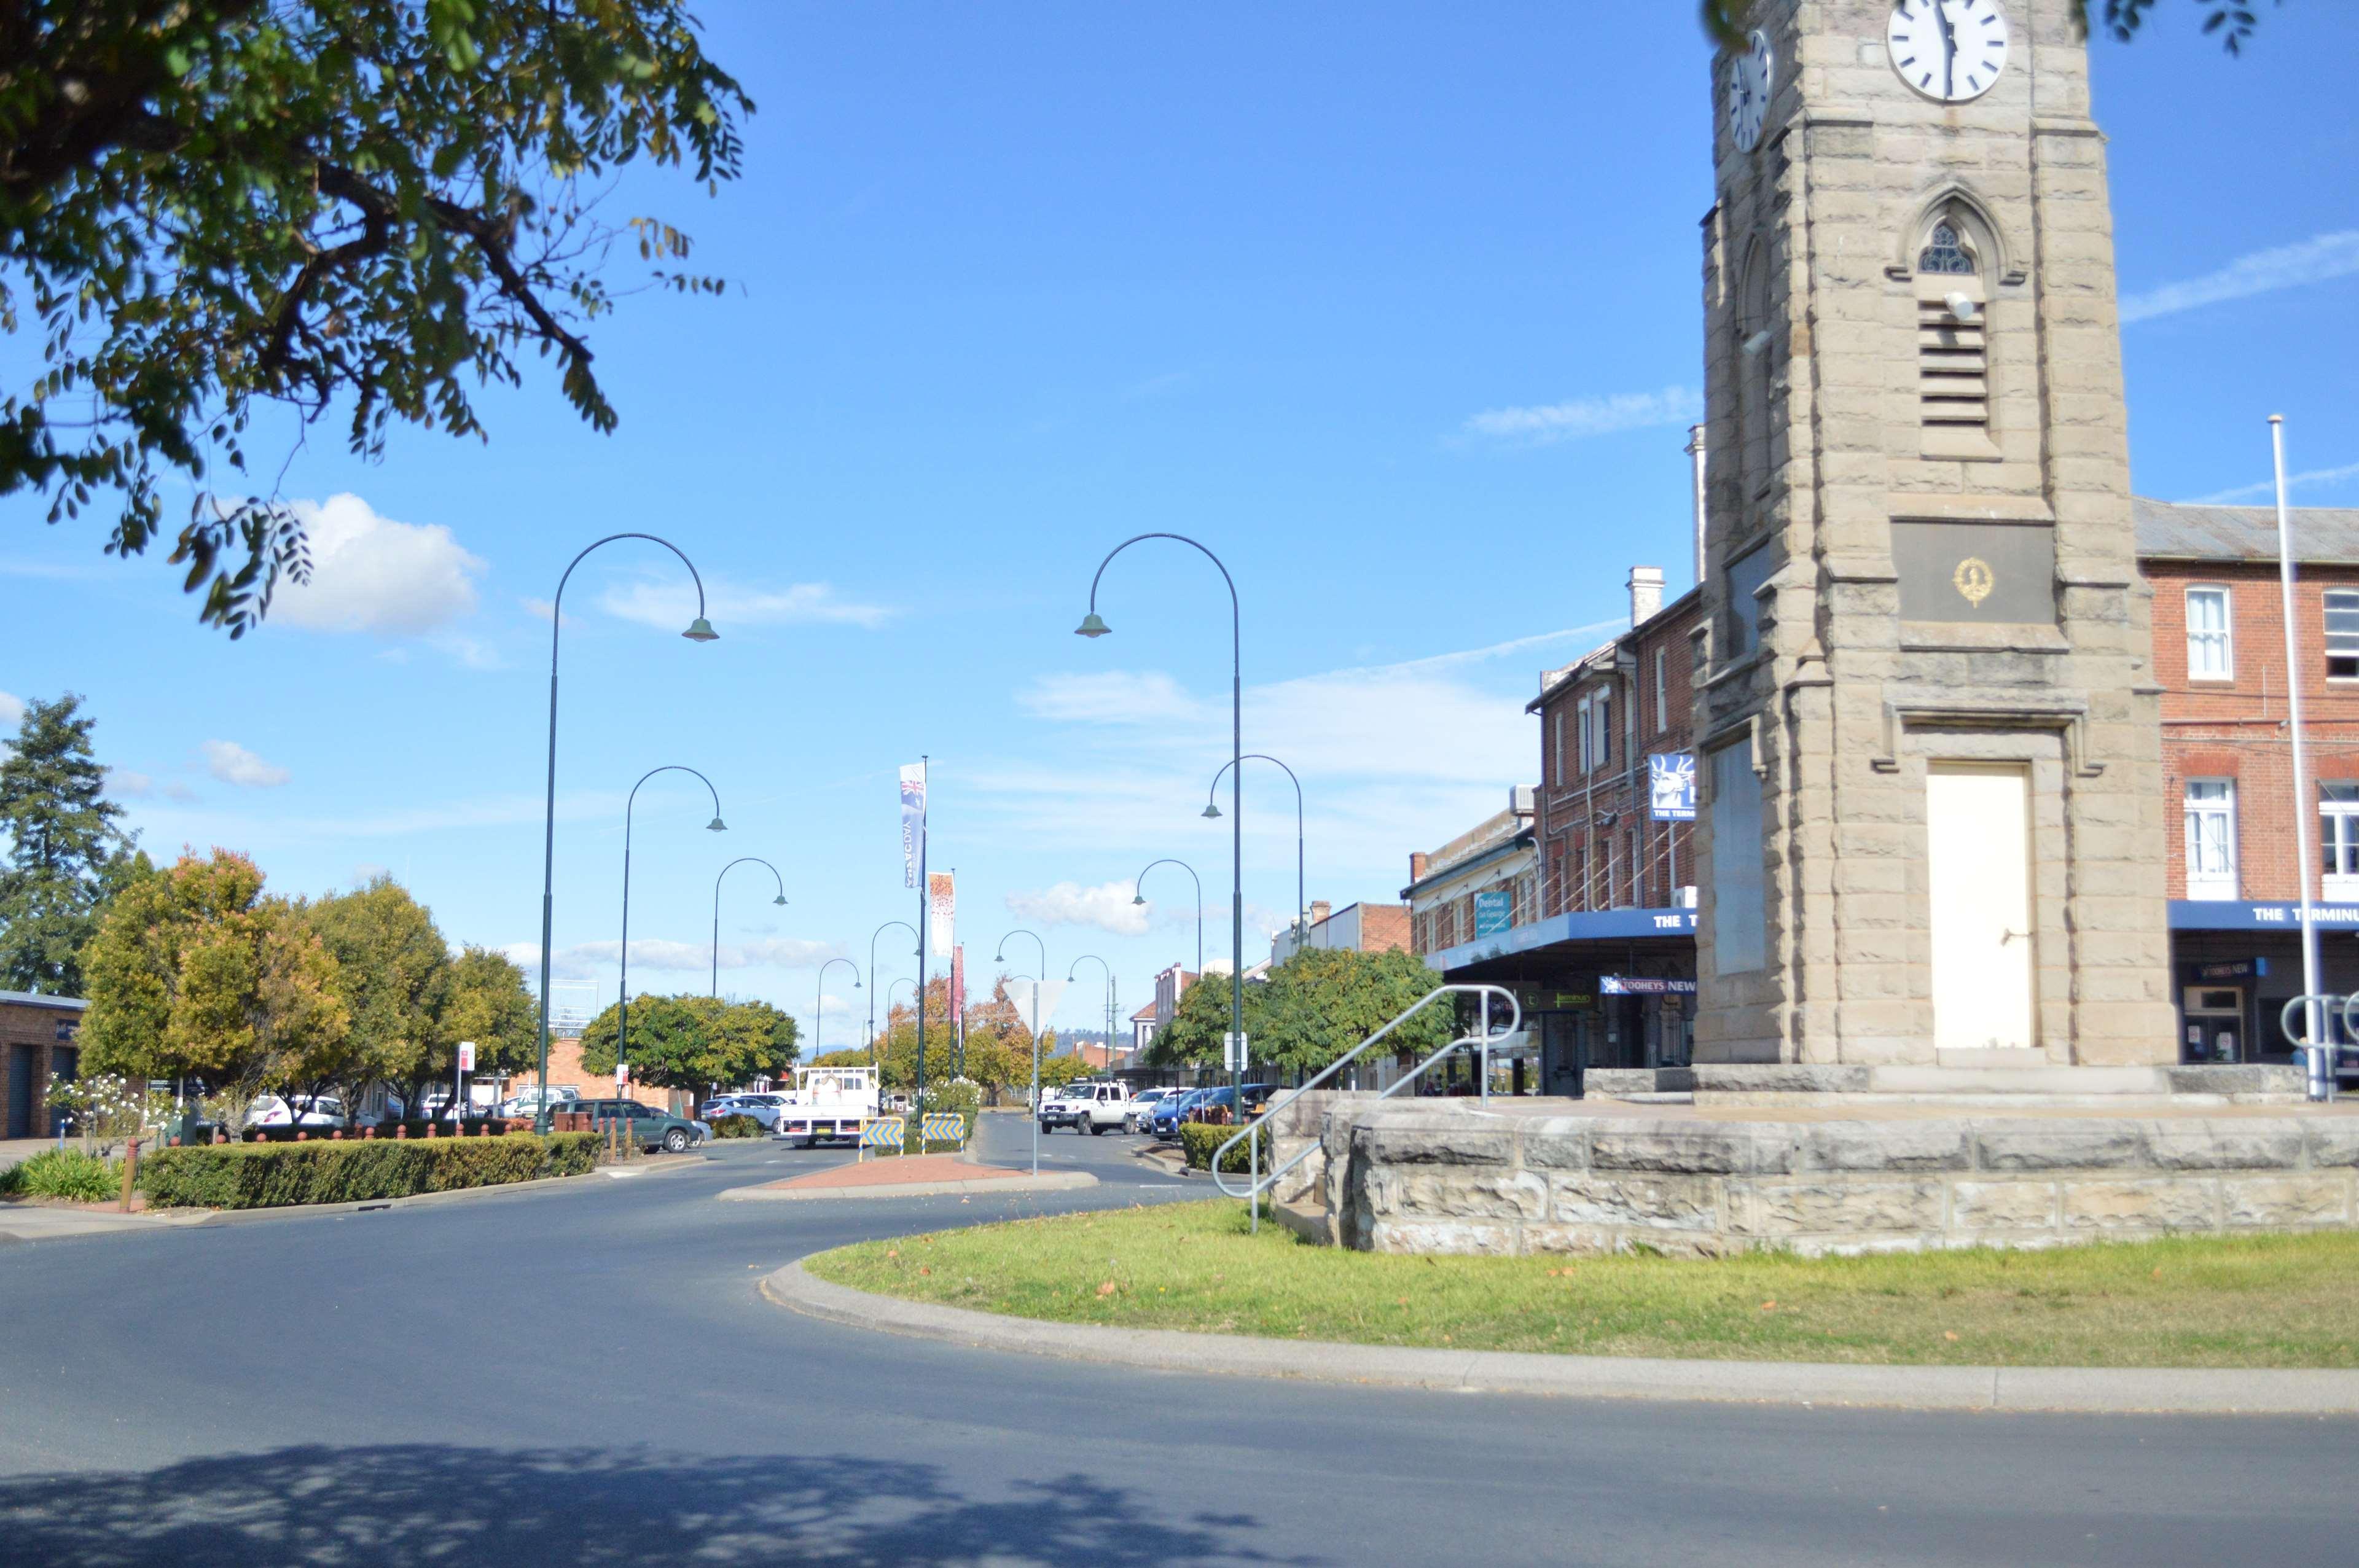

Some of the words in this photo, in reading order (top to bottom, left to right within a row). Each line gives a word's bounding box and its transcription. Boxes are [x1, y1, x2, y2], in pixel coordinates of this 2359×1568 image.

[1479, 897, 1504, 907] Dental
[2253, 908, 2283, 921] THE
[2292, 908, 2359, 922] TRMINU
[1654, 915, 1681, 928] THE
[1668, 981, 1696, 991] NEW
